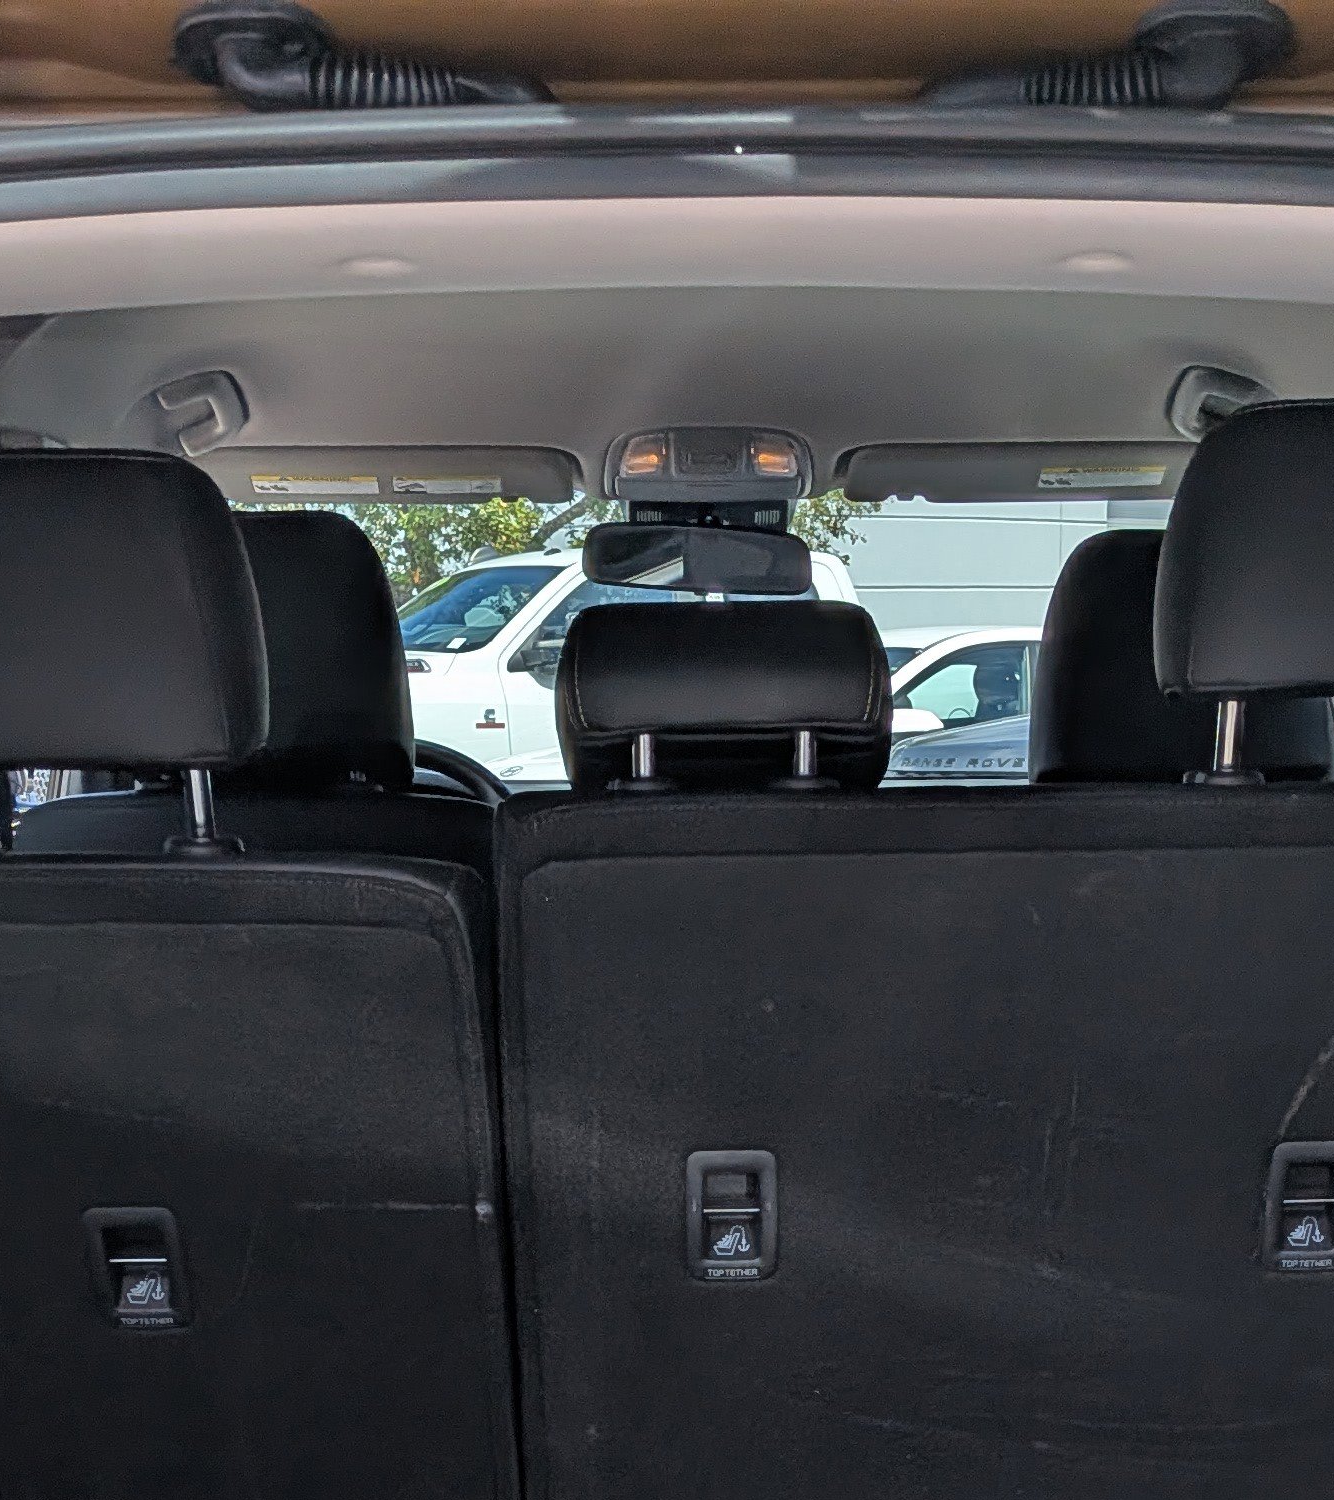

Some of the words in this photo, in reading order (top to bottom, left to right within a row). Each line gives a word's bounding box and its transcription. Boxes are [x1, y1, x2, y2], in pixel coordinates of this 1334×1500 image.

[900, 757, 956, 768] RANGE
[965, 757, 1025, 768] ROVE
[1281, 1259, 1298, 1268] TOP
[1299, 1258, 1332, 1267] TETHER
[707, 1268, 724, 1277] TOP
[725, 1268, 758, 1276] TETHER
[120, 1317, 138, 1325] TOP
